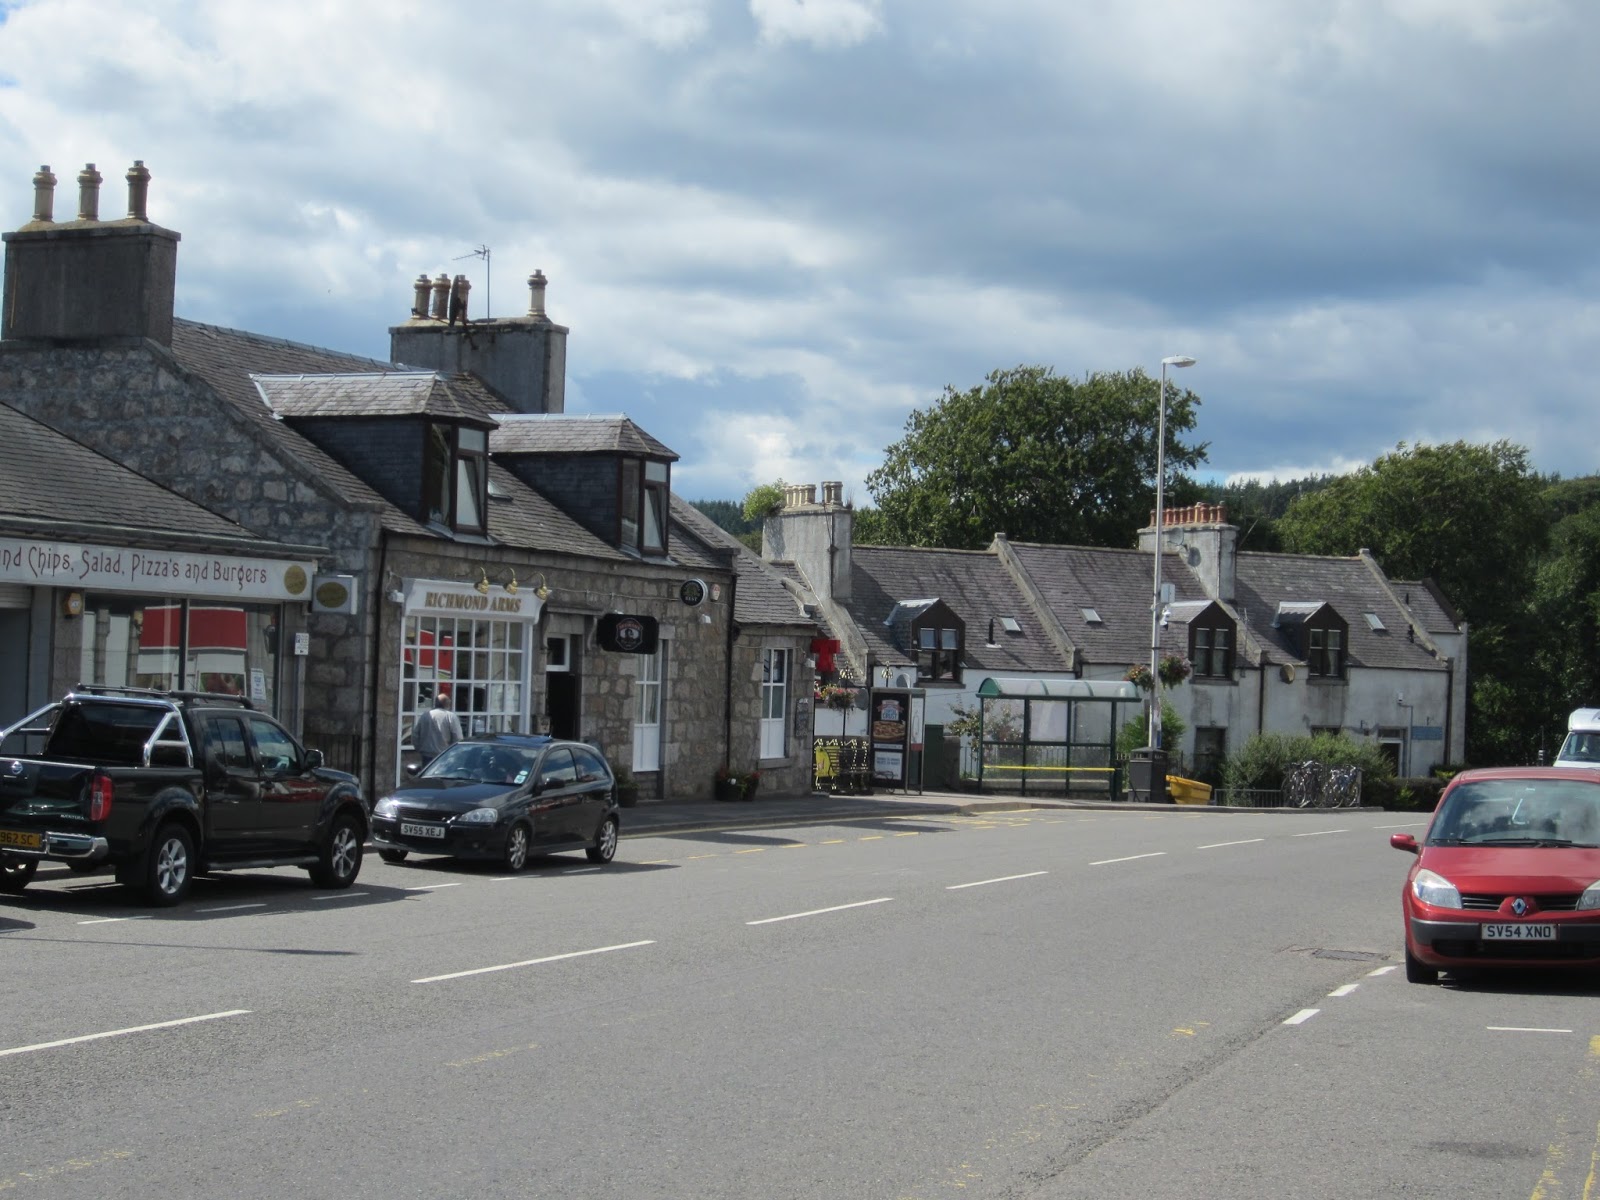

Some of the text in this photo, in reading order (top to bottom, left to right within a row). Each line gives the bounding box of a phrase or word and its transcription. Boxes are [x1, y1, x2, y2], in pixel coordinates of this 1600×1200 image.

[0, 547, 22, 571] nd
[28, 546, 74, 578] Chips,
[131, 554, 180, 582] Pizza's
[185, 561, 208, 583] and
[213, 561, 267, 590] Burgers
[425, 592, 522, 612] RICHMOND ARMS
[403, 824, 442, 837] SV55 XEJ
[20, 834, 34, 845] SC
[1487, 925, 1522, 938] SV54
